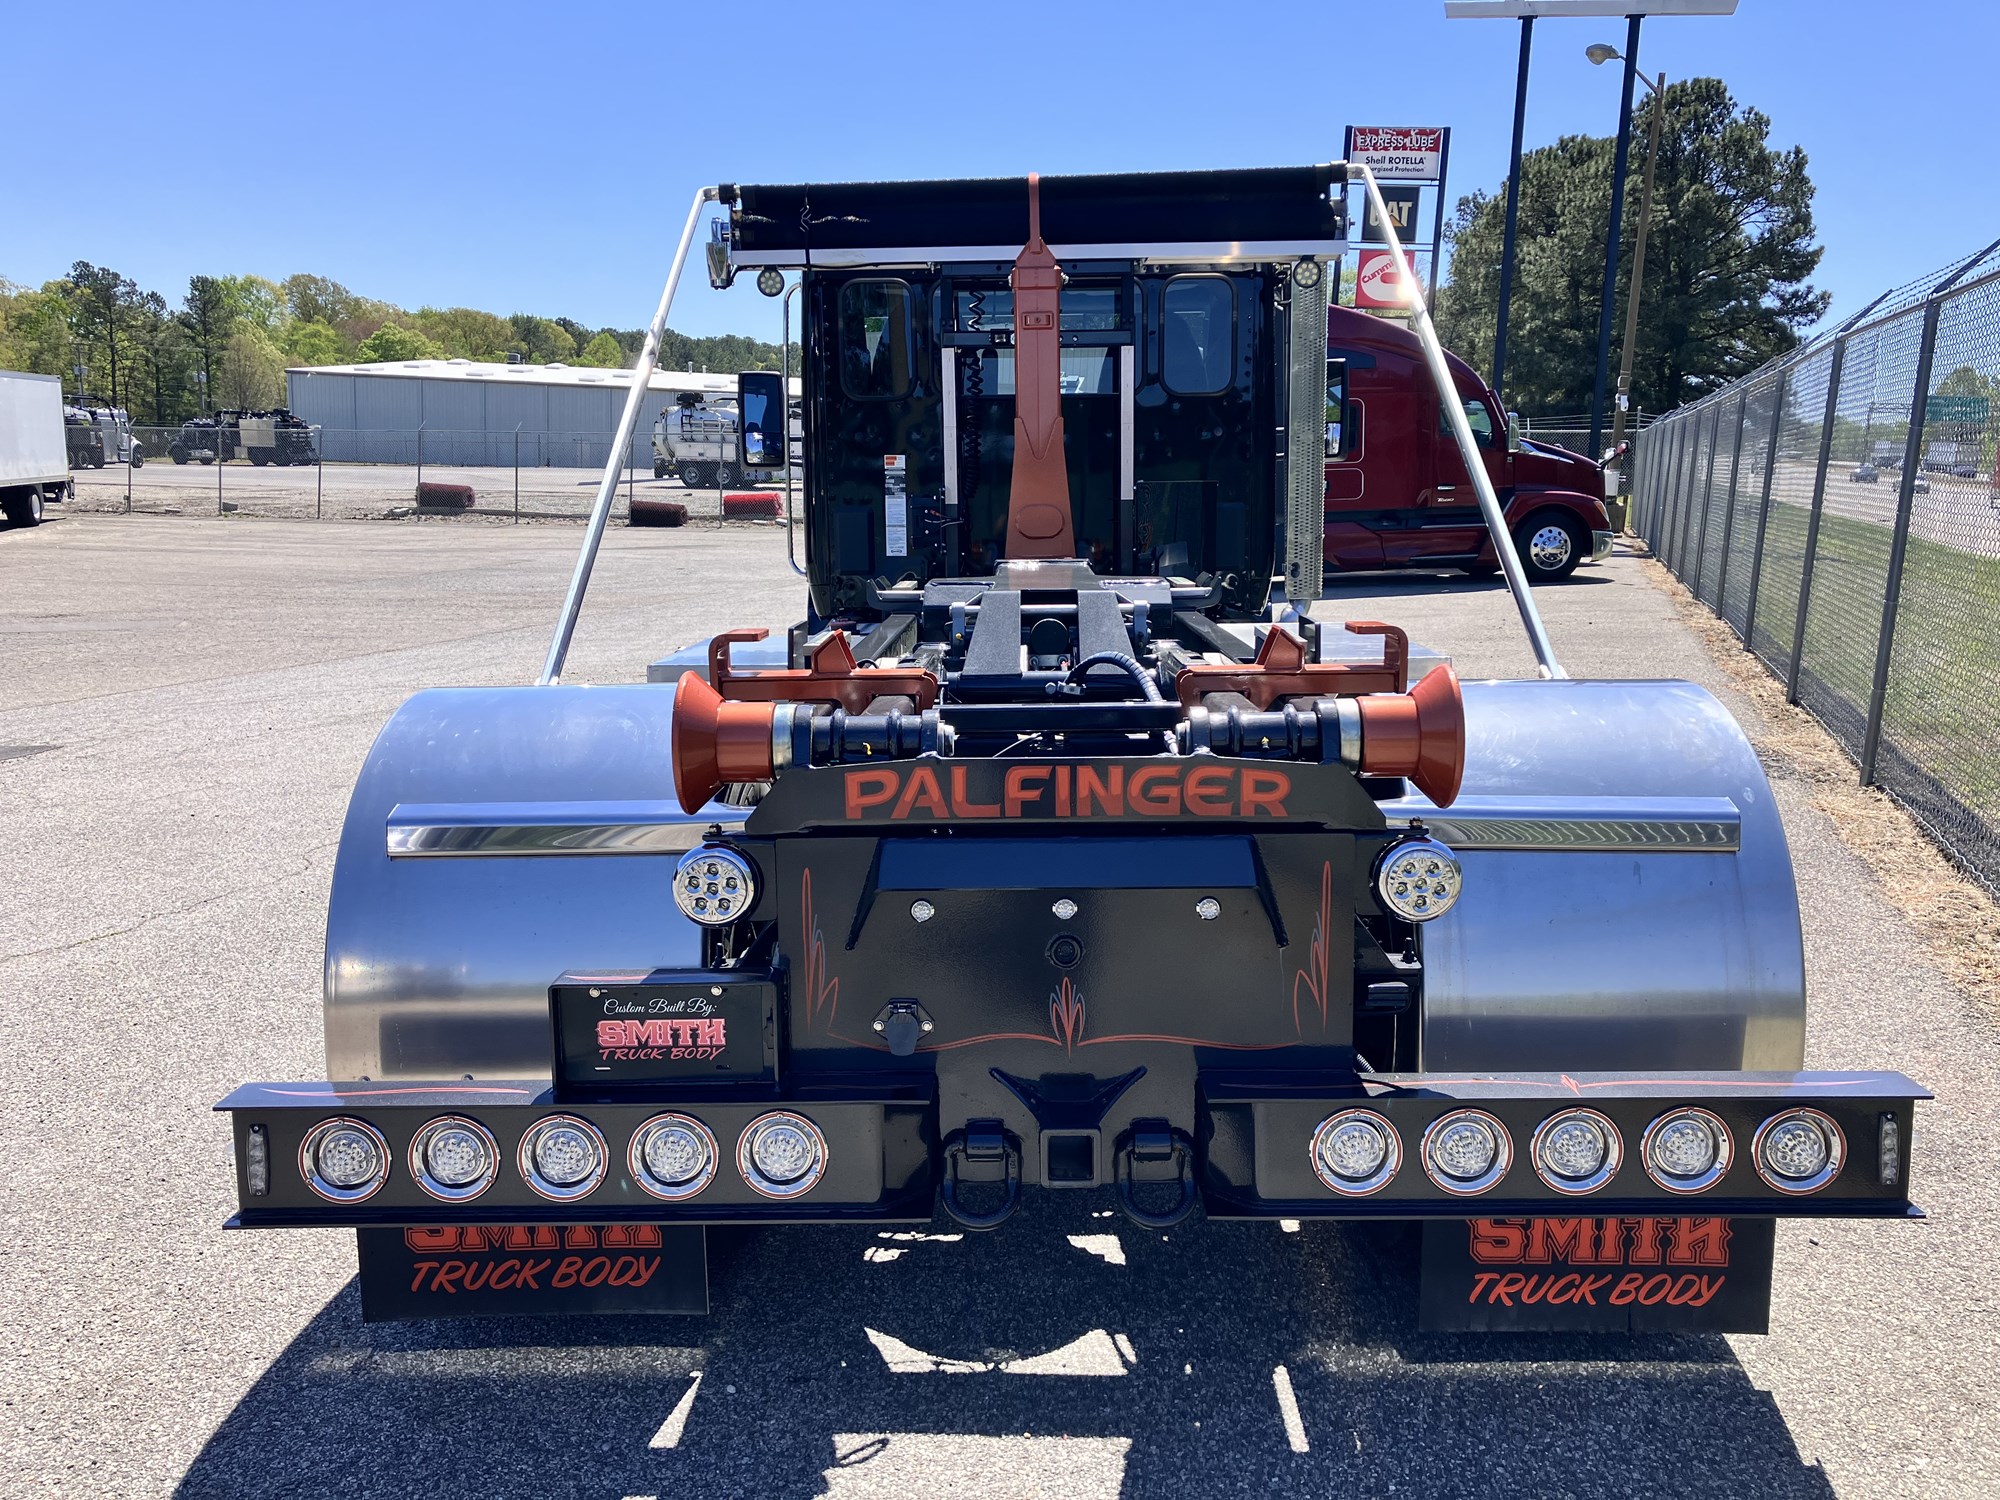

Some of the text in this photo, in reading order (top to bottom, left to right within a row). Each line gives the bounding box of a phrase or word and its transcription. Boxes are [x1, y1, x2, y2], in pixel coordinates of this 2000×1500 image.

[1359, 135, 1435, 147] EXPRESS LUBE
[1365, 155, 1386, 165] Shell
[1362, 258, 1394, 284] Cummi
[844, 765, 1291, 820] PALFINGER
[603, 997, 717, 1017] Custom Built By:
[596, 1018, 726, 1047] SMITH
[599, 1046, 725, 1061] TRUCK BODY
[1466, 1218, 1733, 1267] SMITH
[411, 1255, 662, 1294] TRUCK BODY
[1469, 1272, 1726, 1307] TRUCK BODY
